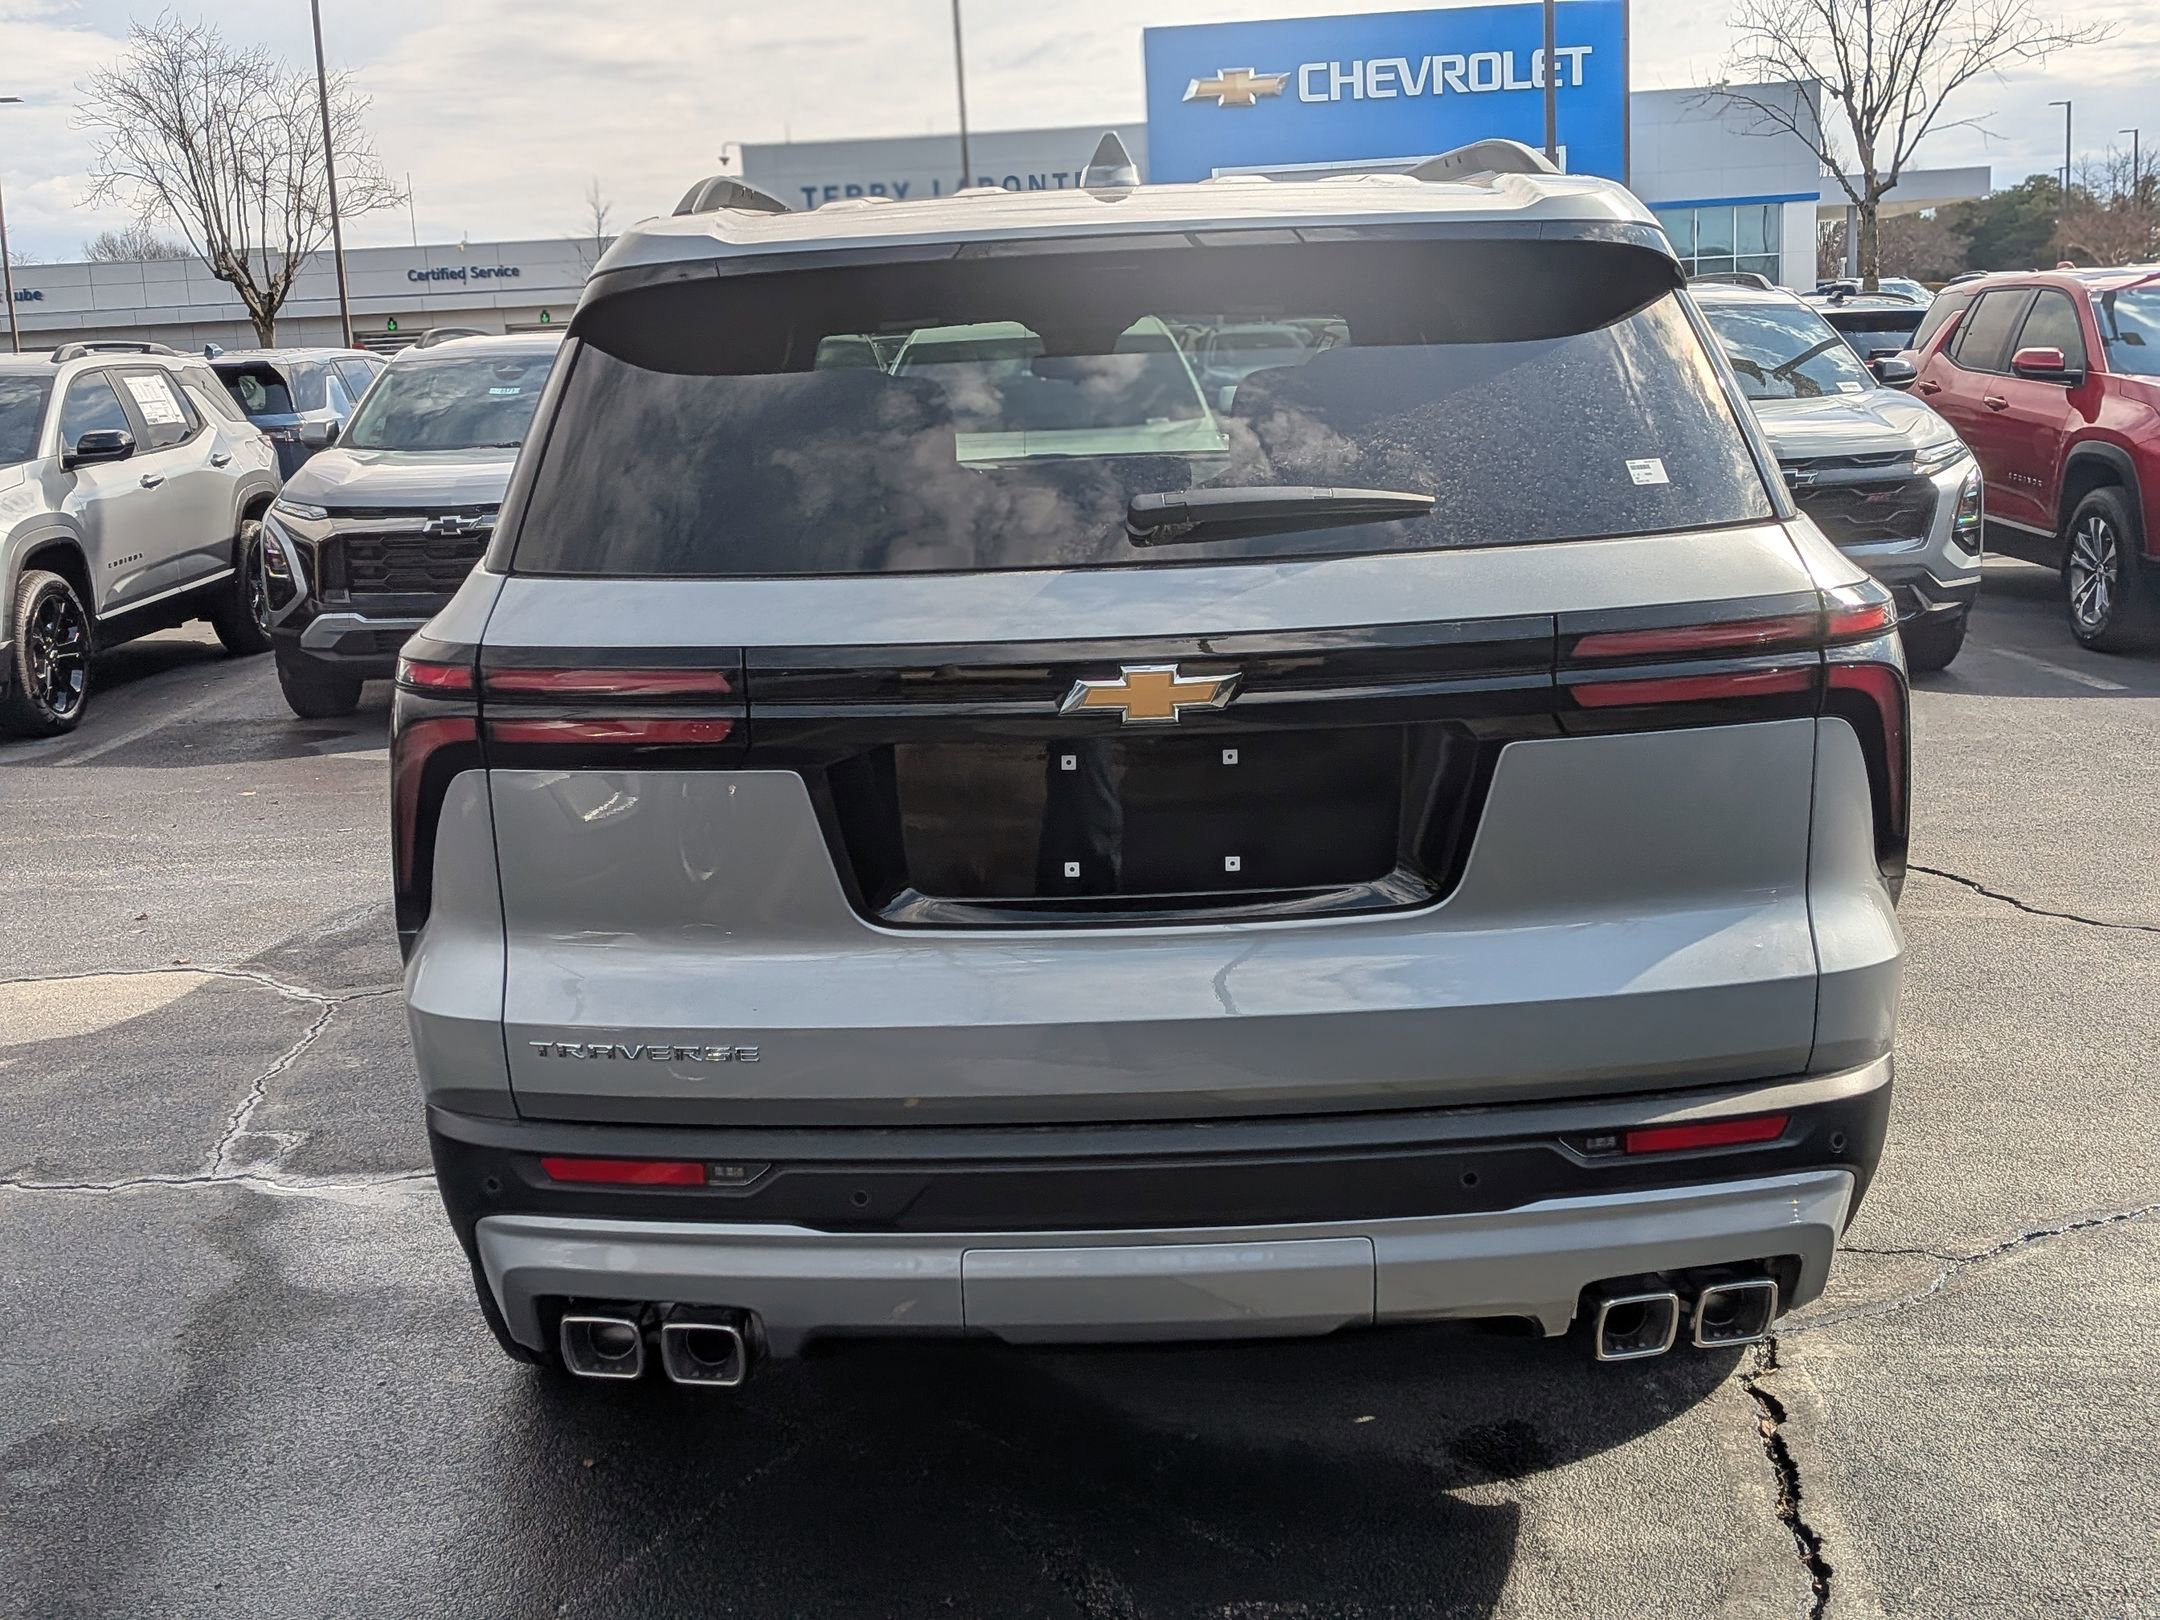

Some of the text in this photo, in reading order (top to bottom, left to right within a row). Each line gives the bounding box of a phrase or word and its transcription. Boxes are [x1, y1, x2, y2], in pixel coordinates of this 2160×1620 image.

[1298, 46, 1592, 103] CHEVROLET
[800, 181, 909, 209] TERRY
[407, 265, 520, 283] Certified Service
[13, 288, 44, 302] ube
[528, 1040, 761, 1063] TRAVERSE
